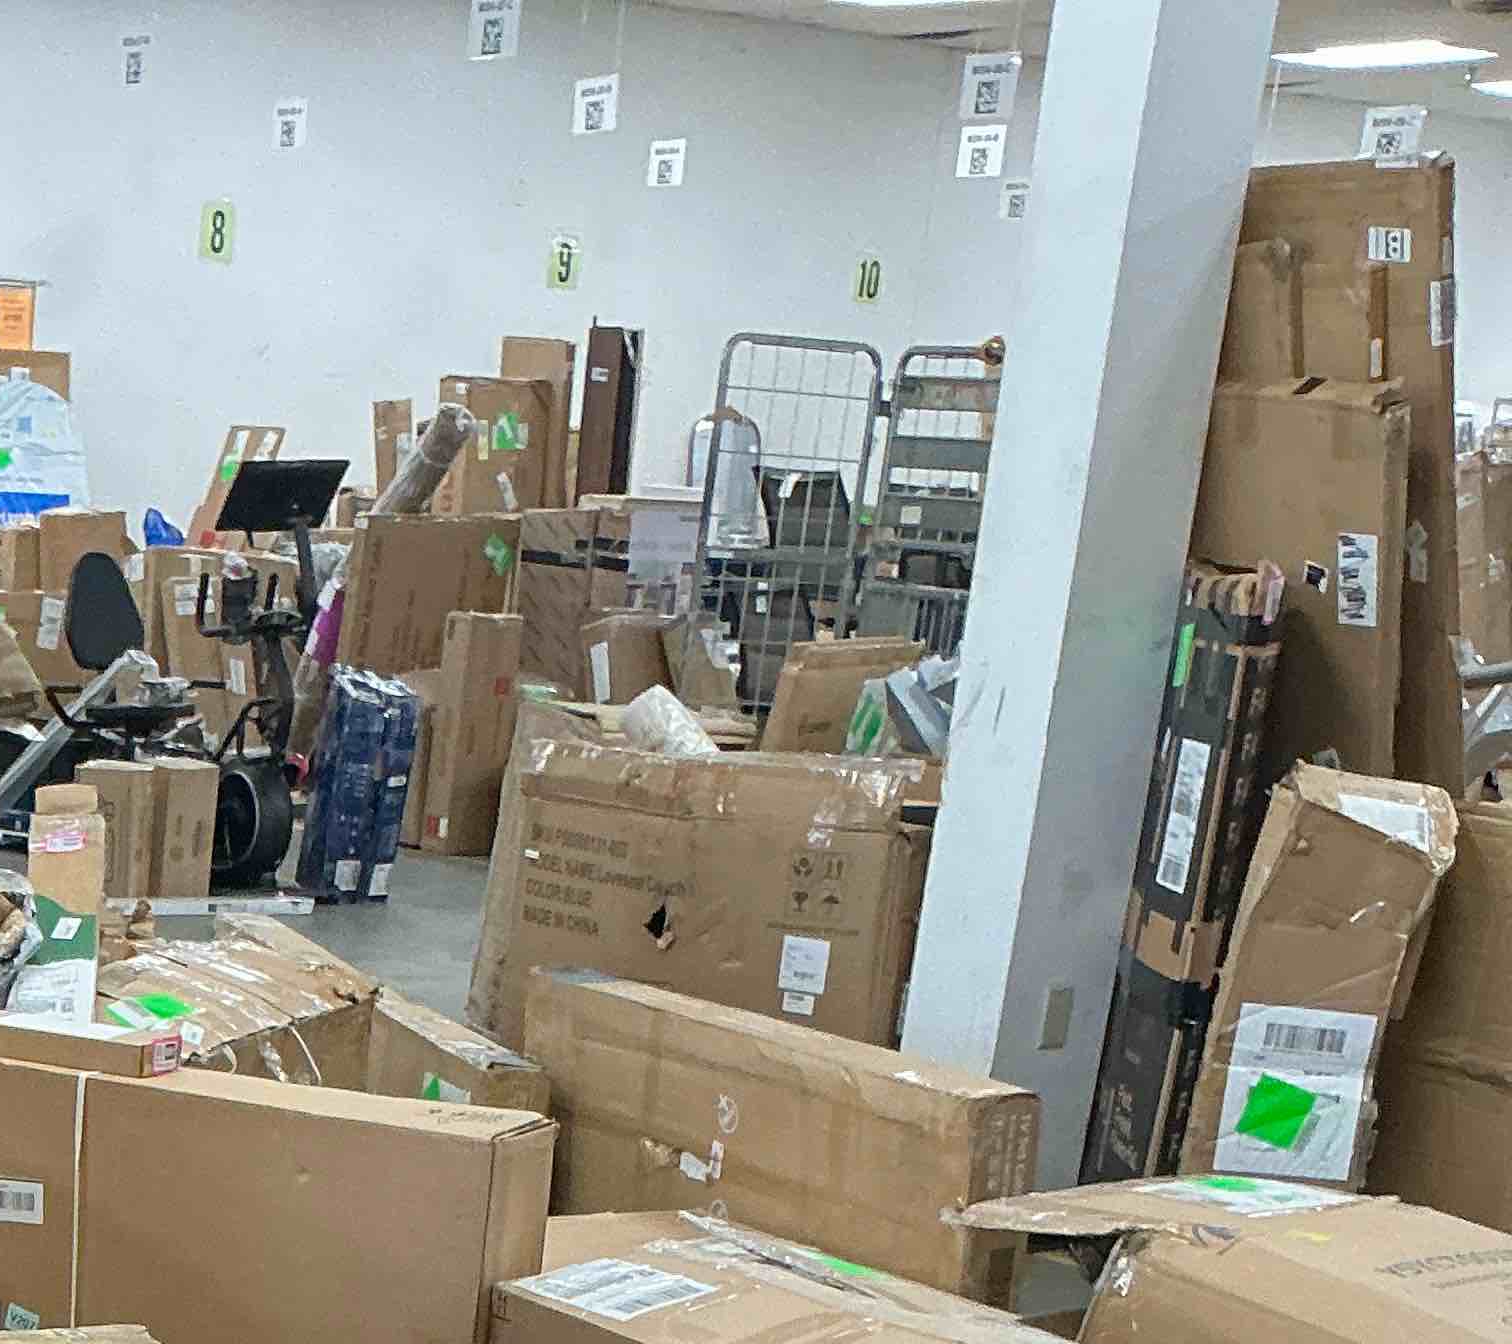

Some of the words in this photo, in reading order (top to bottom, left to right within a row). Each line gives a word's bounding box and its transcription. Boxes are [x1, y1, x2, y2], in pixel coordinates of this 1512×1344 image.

[210, 209, 225, 254] 8
[557, 243, 572, 285] 9
[857, 260, 880, 299] 10
